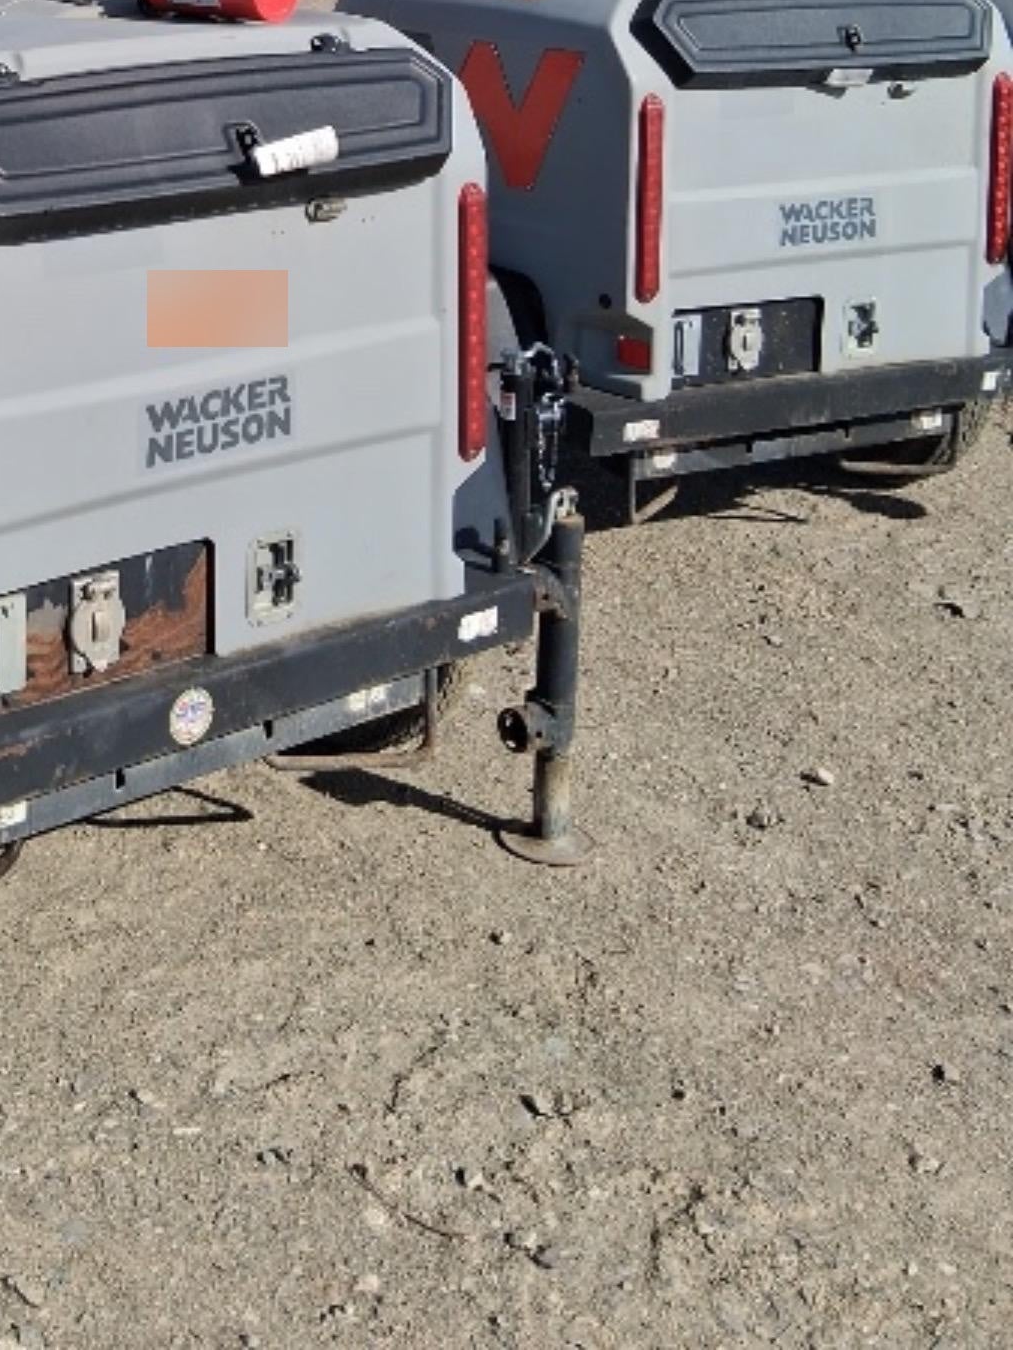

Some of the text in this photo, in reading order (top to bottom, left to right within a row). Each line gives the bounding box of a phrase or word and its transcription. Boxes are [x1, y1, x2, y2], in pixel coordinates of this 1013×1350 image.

[779, 197, 876, 225] WACKER
[779, 219, 877, 247] NEUSON
[145, 374, 291, 433] WACKER
[145, 407, 291, 469] NEUSON
